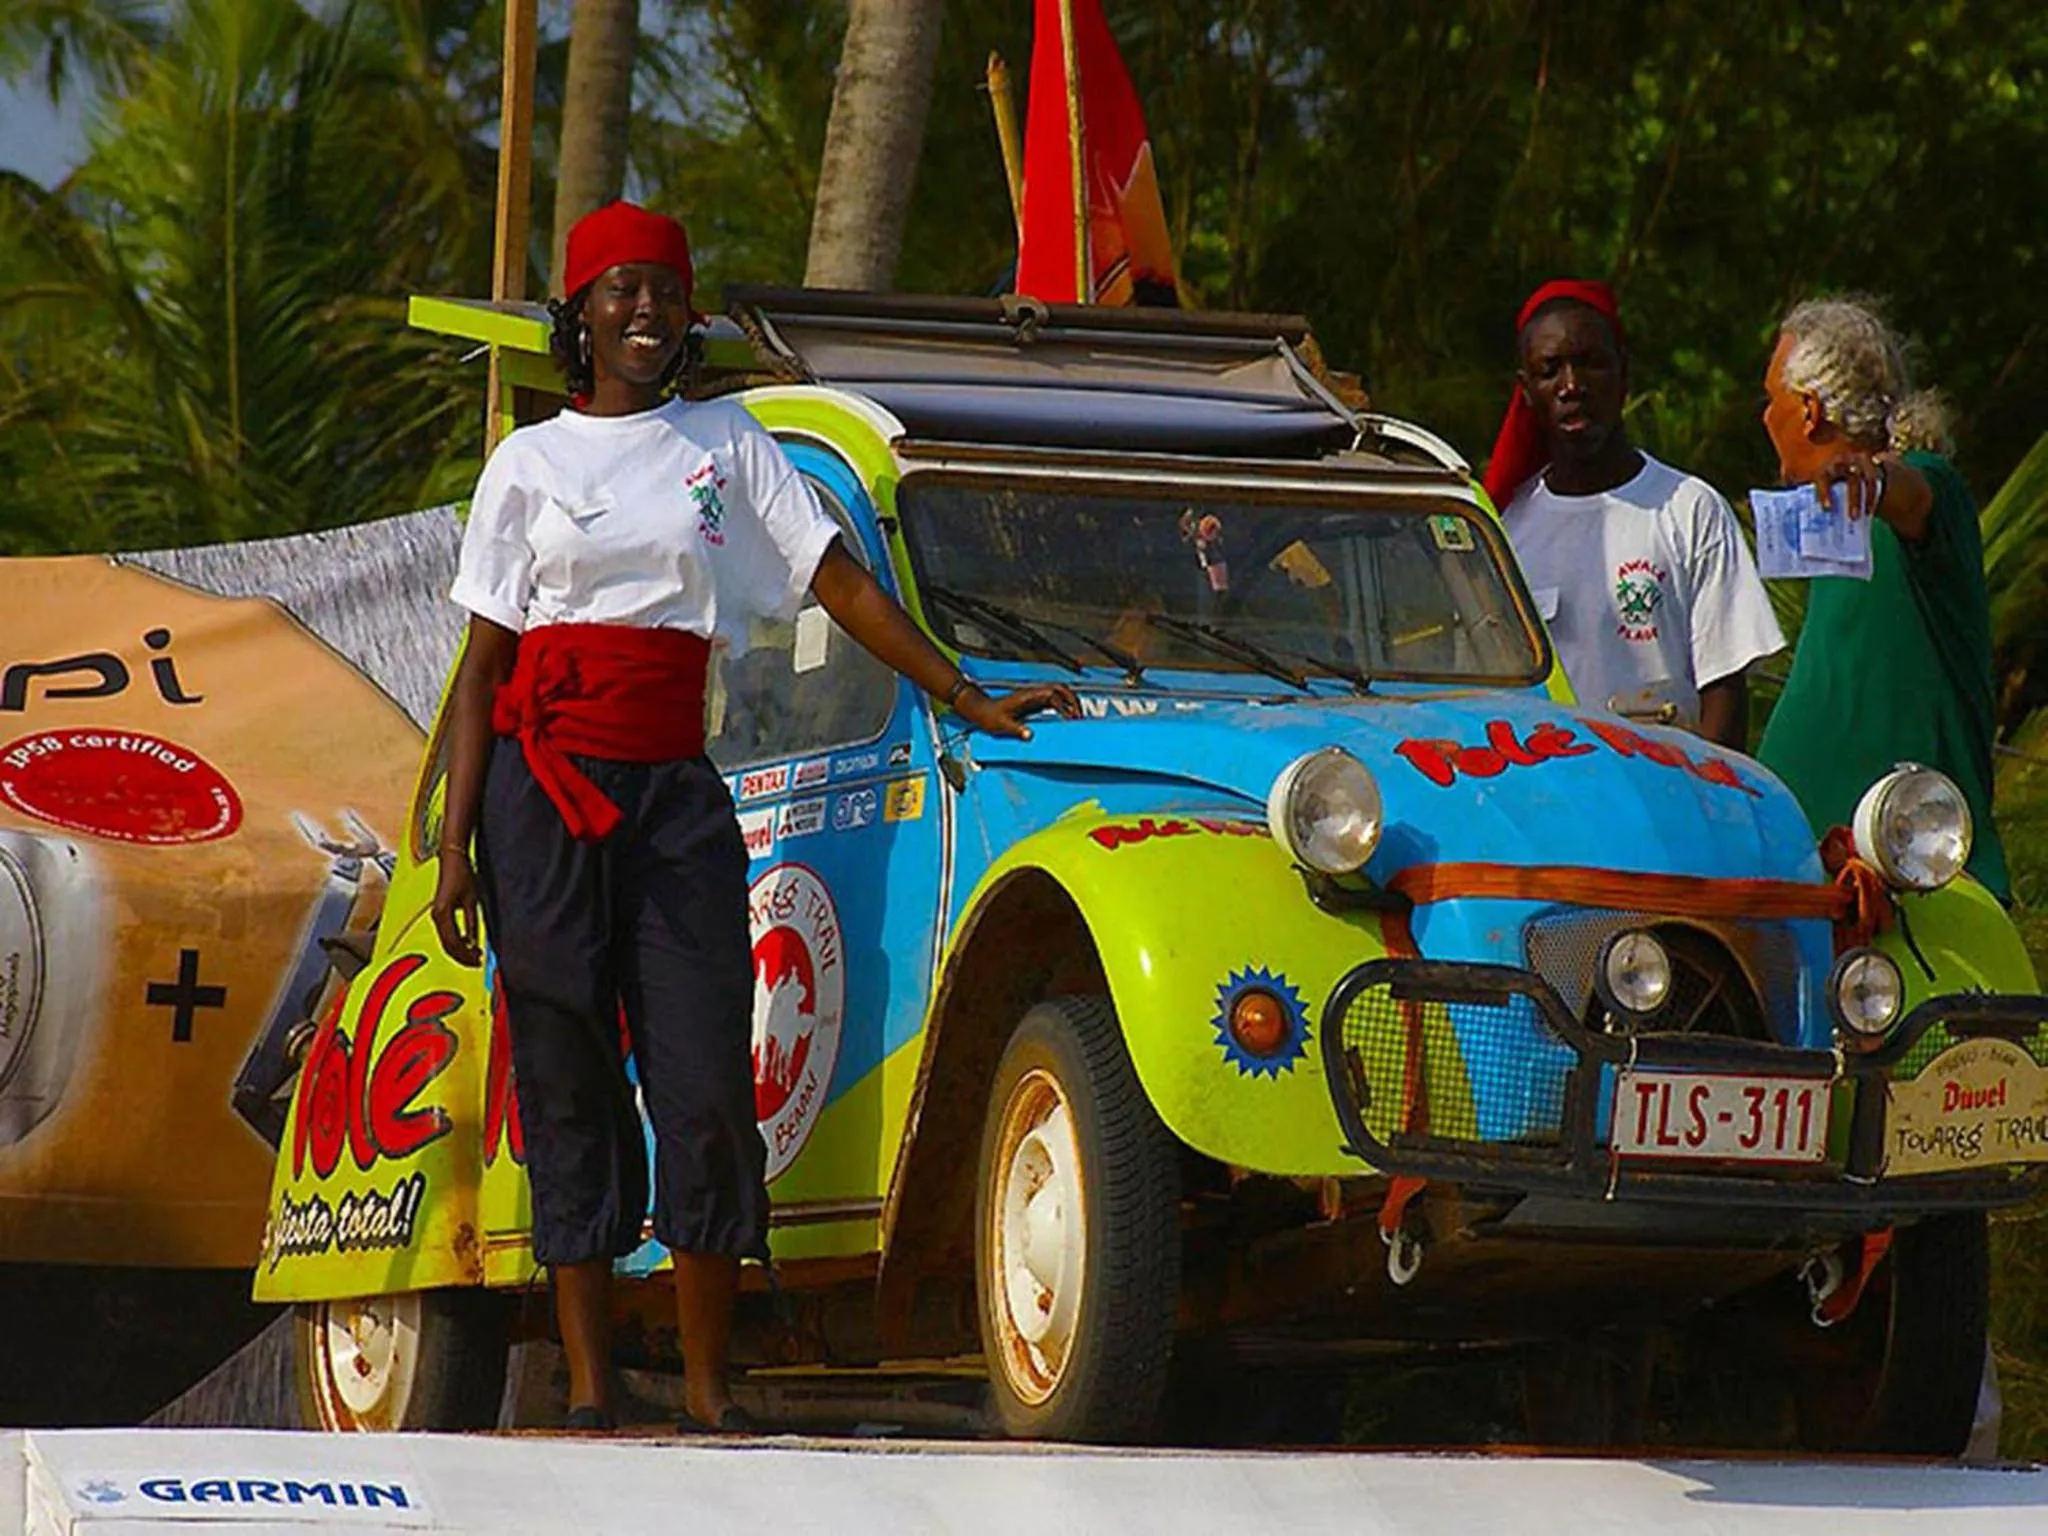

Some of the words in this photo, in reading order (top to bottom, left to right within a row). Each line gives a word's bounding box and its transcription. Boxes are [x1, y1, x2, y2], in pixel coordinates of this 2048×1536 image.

[69, 734, 197, 773] certified
[1943, 1076, 2007, 1115] Duvel
[1634, 1081, 1814, 1152] TLS-311
[140, 1478, 411, 1508] GARMIN
